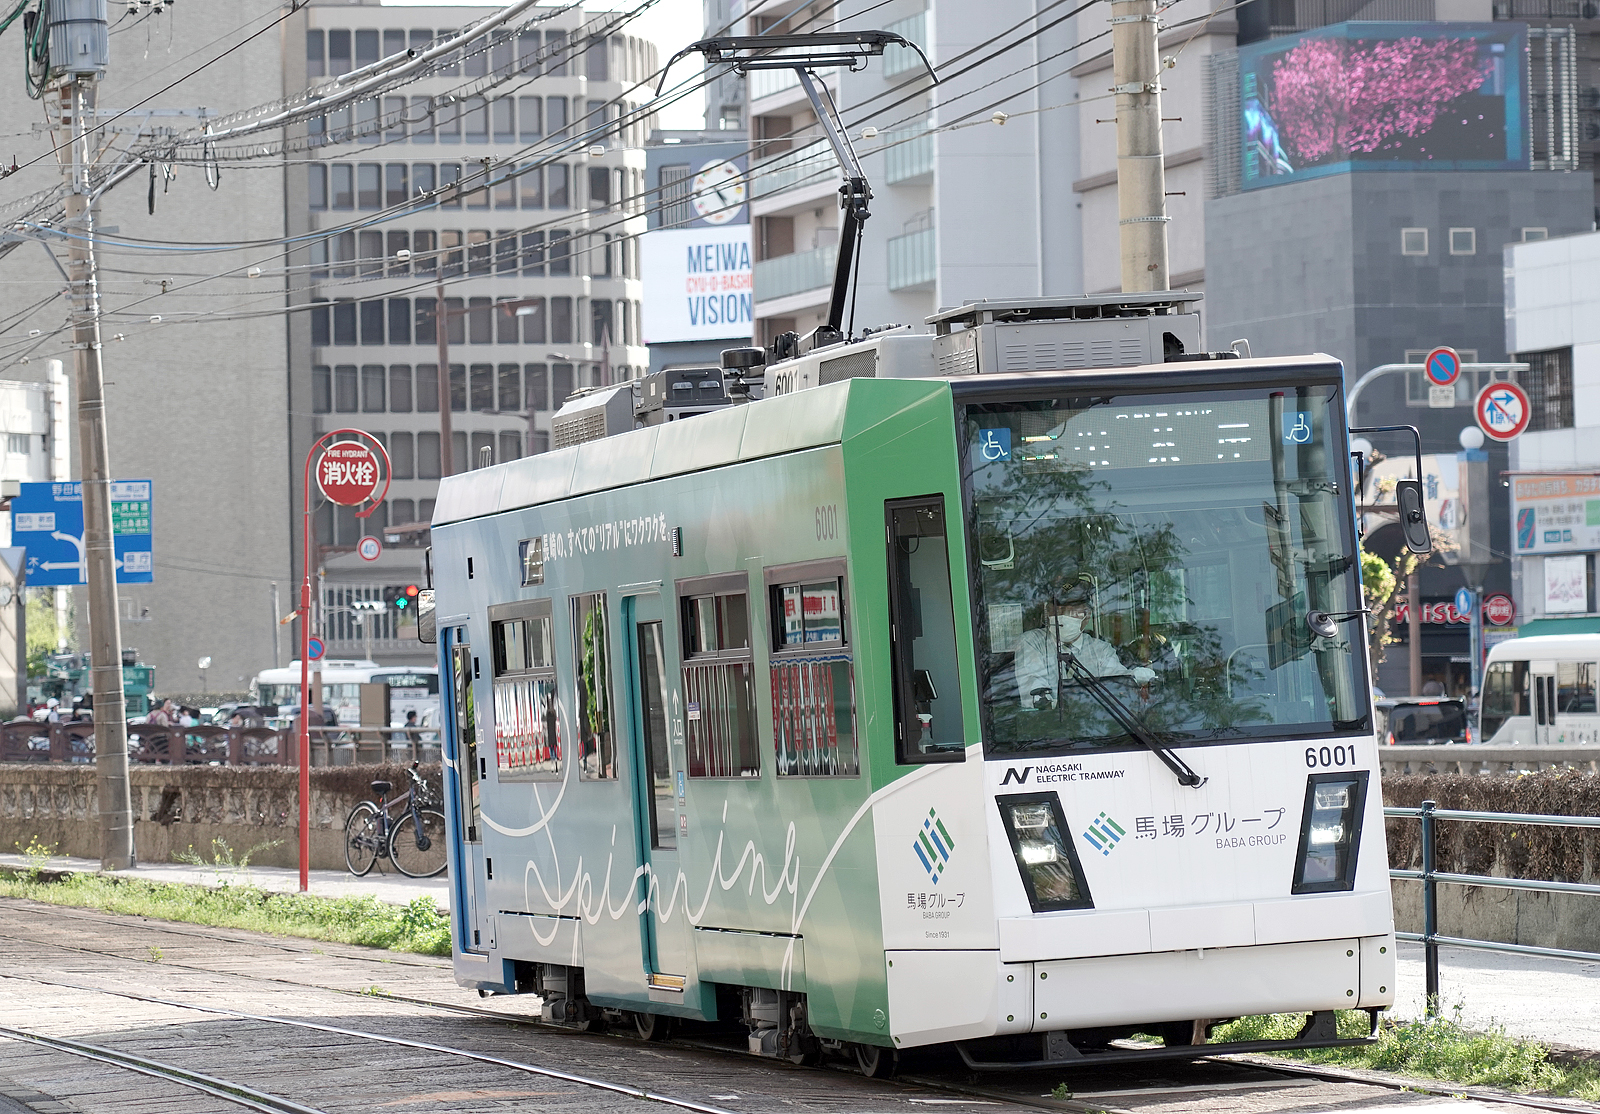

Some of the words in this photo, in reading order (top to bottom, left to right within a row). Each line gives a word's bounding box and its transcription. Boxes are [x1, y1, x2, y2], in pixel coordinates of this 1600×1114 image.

[687, 242, 751, 273] MEIWA
[687, 293, 753, 325] VISION
[323, 461, 374, 485] 消火栓
[815, 504, 838, 541] 6001
[363, 542, 377, 556] 40
[1305, 745, 1356, 768] 6001
[1035, 763, 1082, 774] NAGASAKI
[1036, 773, 1077, 783] ELECTRIC
[1079, 770, 1125, 781] TRAMWAY
[1135, 807, 1286, 840] 馬場グループ
[1216, 837, 1246, 849] BABA
[1248, 833, 1287, 847] GROUP
[907, 892, 965, 910] 馬場グループ
[922, 911, 935, 919] BABA
[935, 911, 950, 919] GROUP
[938, 930, 949, 938] 1931
